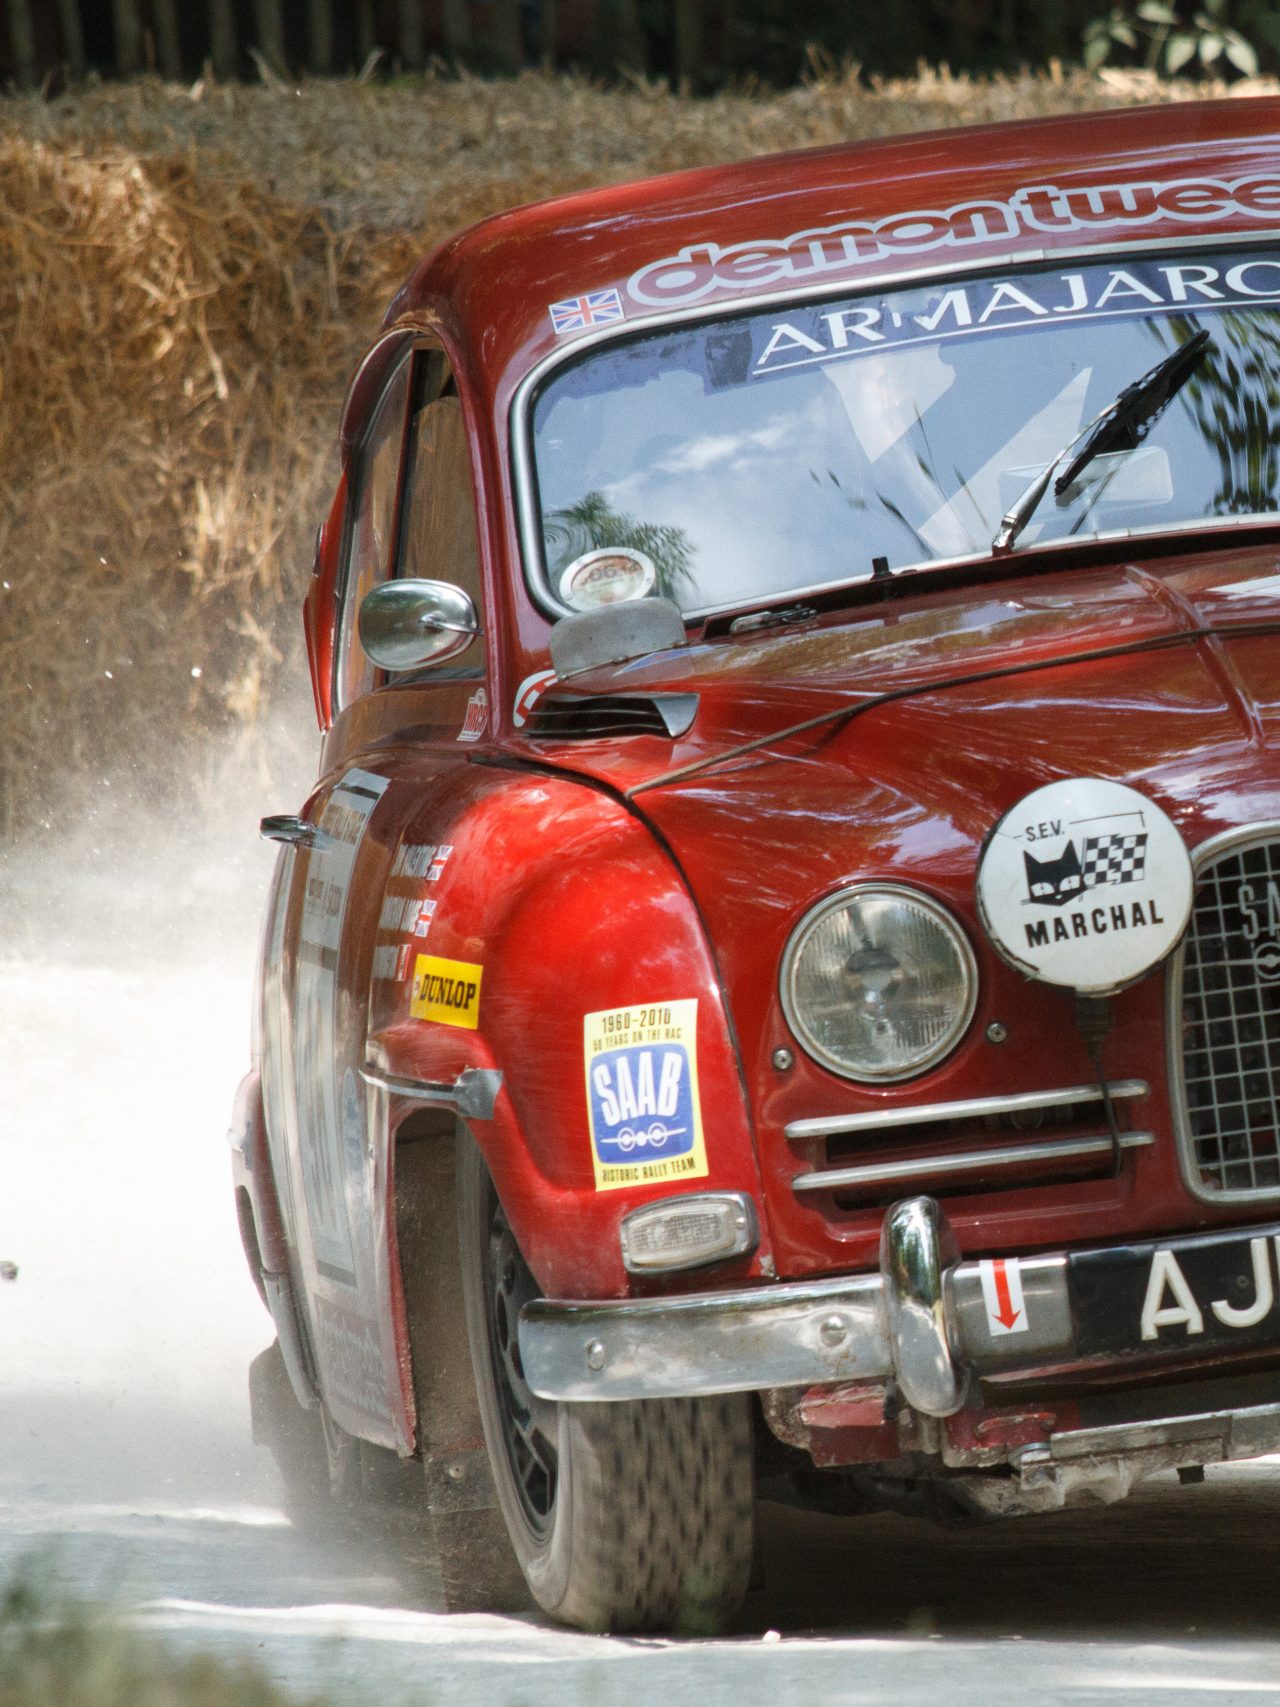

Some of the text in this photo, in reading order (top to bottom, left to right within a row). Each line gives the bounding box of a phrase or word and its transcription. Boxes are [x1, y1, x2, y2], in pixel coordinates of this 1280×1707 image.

[1024, 900, 1164, 948] MARCHAL
[419, 974, 476, 1009] DUNLOP
[602, 1007, 671, 1034] 1960-2010
[593, 1051, 683, 1127] SAAB
[602, 1157, 697, 1182] HISTORIC RALLY TEAM
